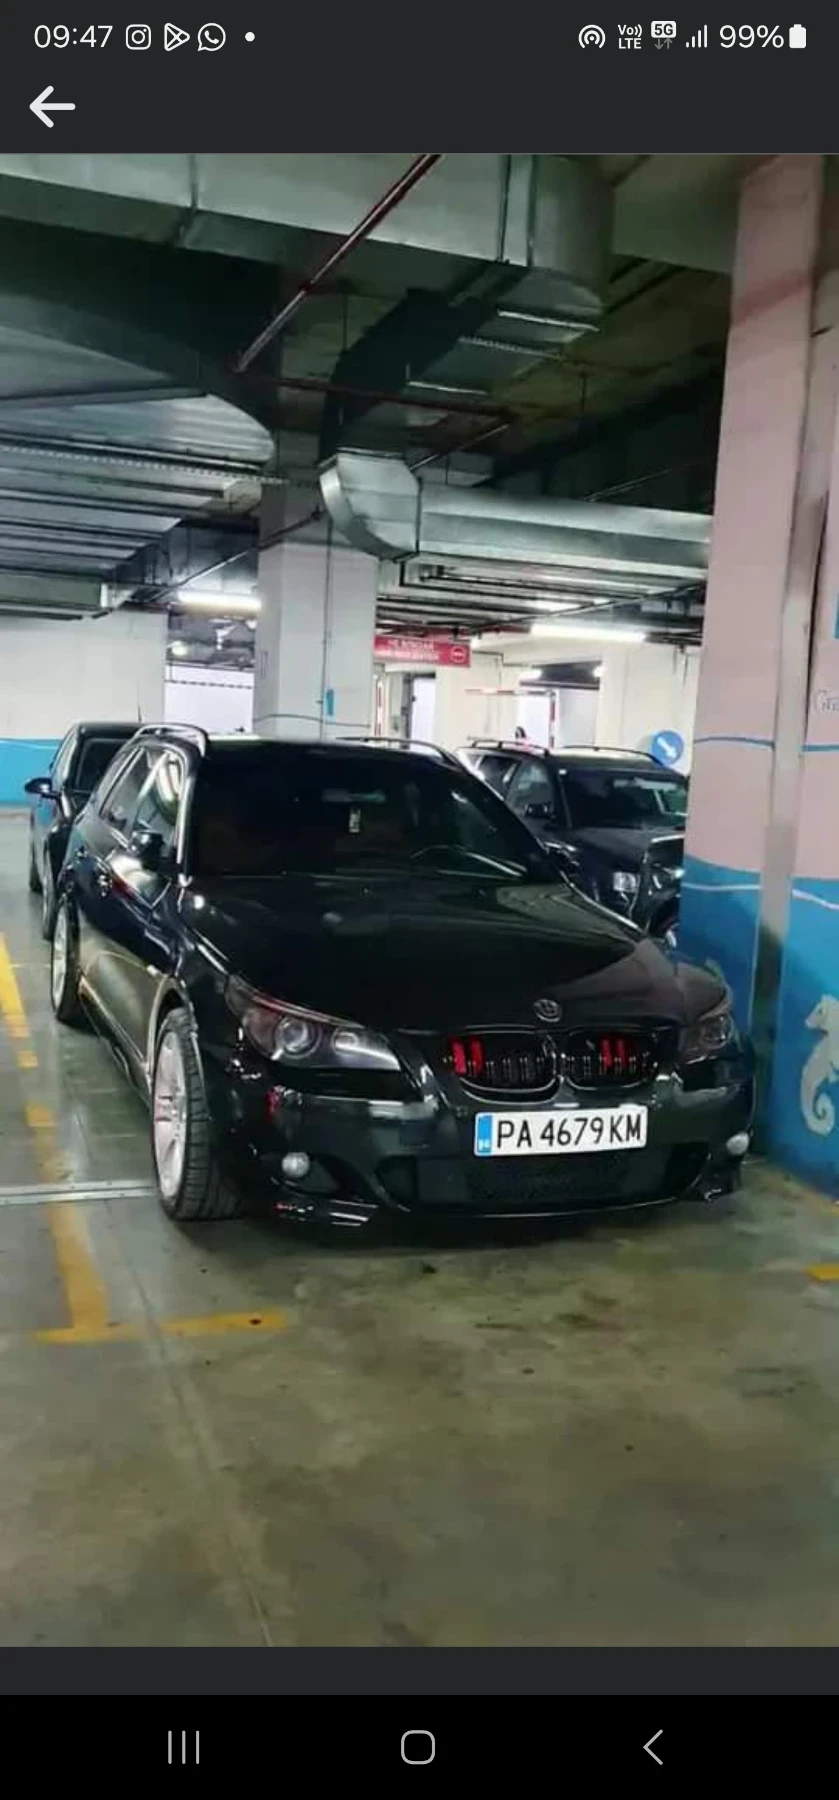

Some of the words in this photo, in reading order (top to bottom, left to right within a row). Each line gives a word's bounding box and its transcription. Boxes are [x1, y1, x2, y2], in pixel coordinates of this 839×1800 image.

[496, 1118, 533, 1149] PA
[539, 1116, 605, 1147] 4679
[608, 1113, 642, 1144] KM
